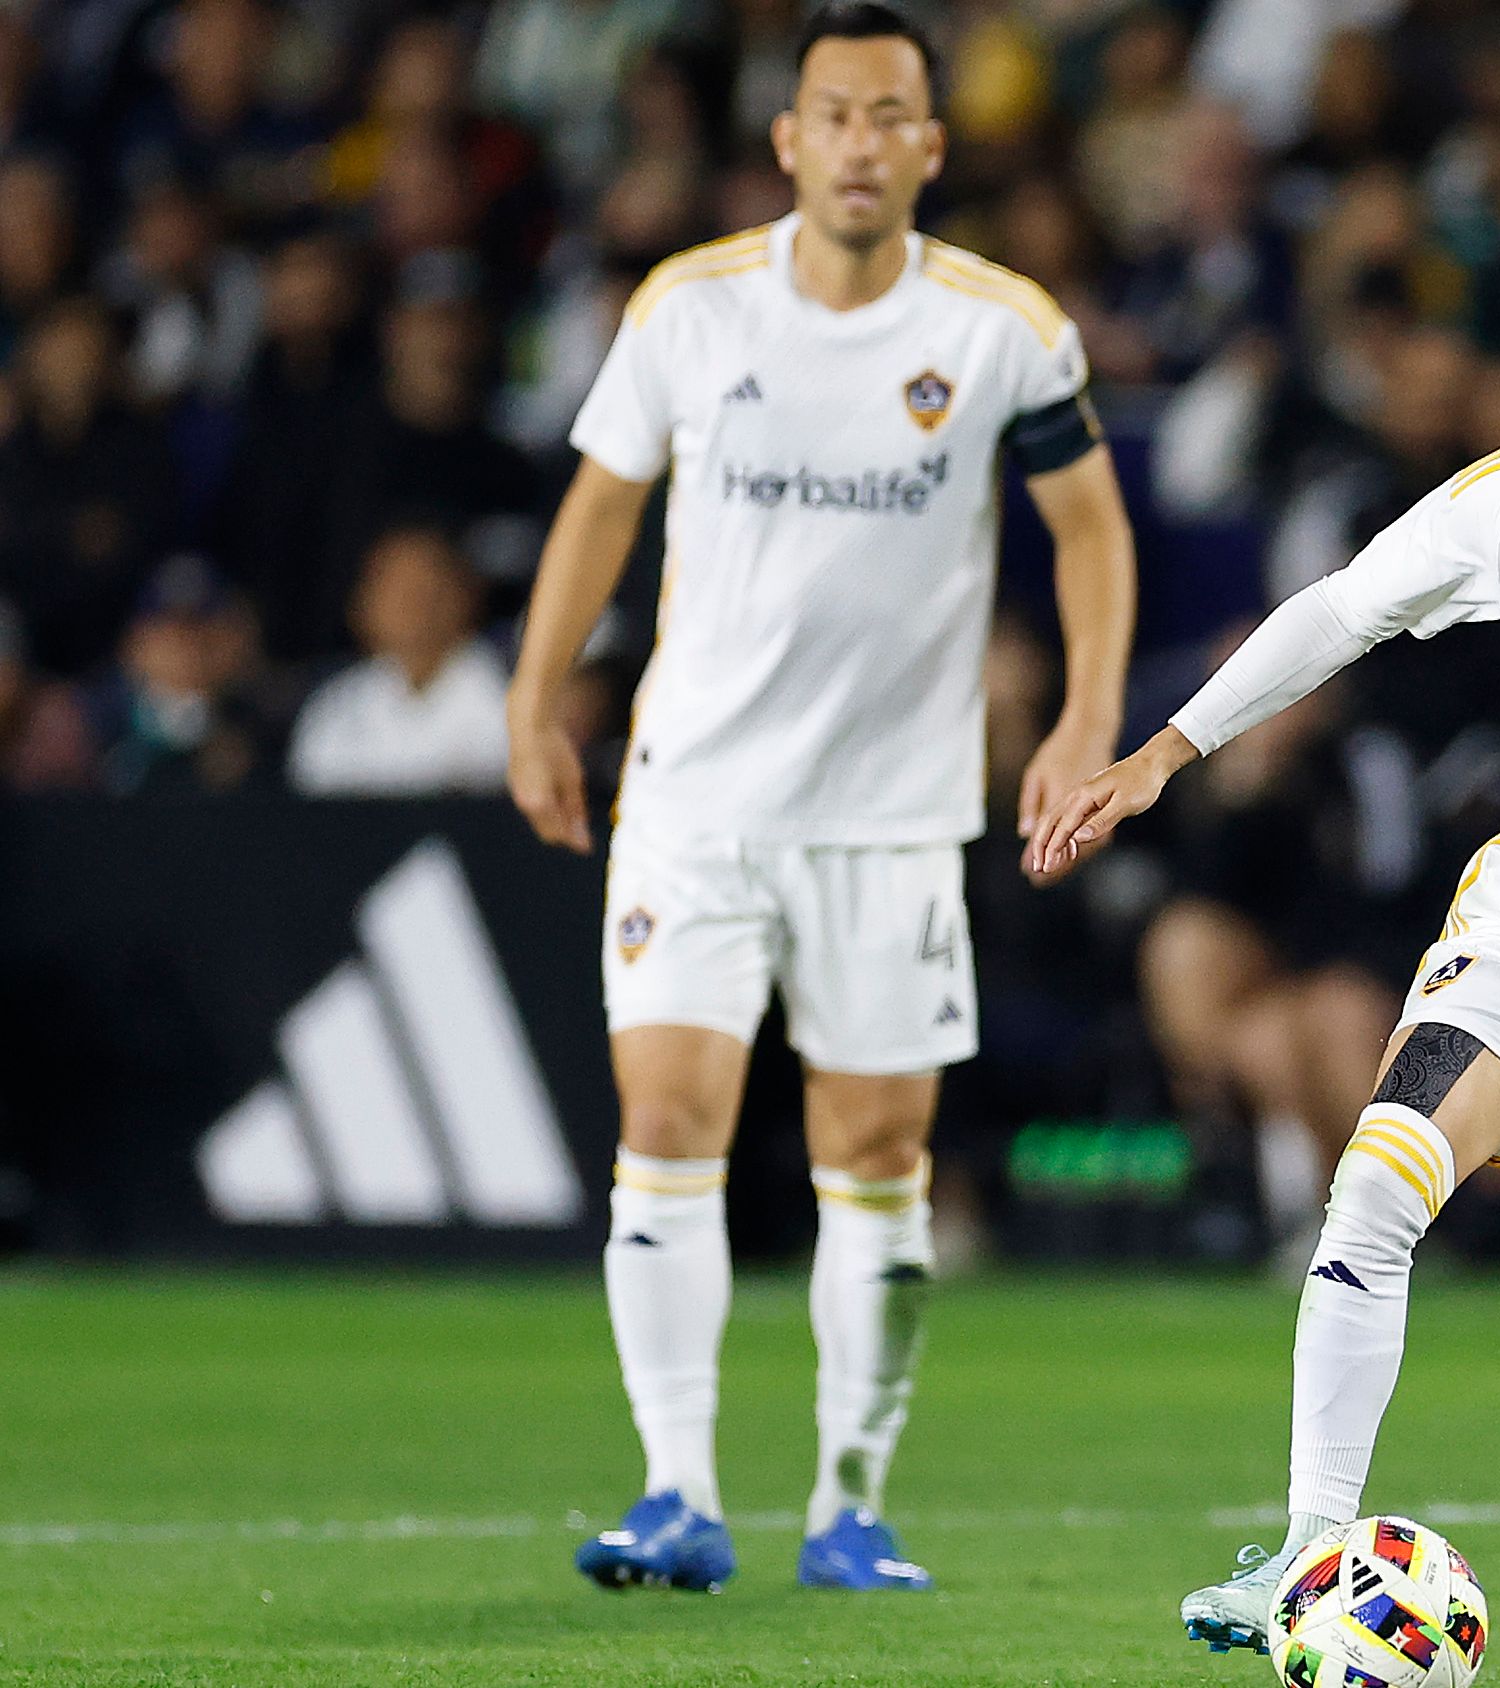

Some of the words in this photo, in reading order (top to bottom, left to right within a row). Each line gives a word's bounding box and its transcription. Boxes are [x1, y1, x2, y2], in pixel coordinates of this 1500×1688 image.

[723, 463, 930, 514] Herbalife
[917, 893, 955, 971] 4
[1428, 965, 1458, 984] LA
